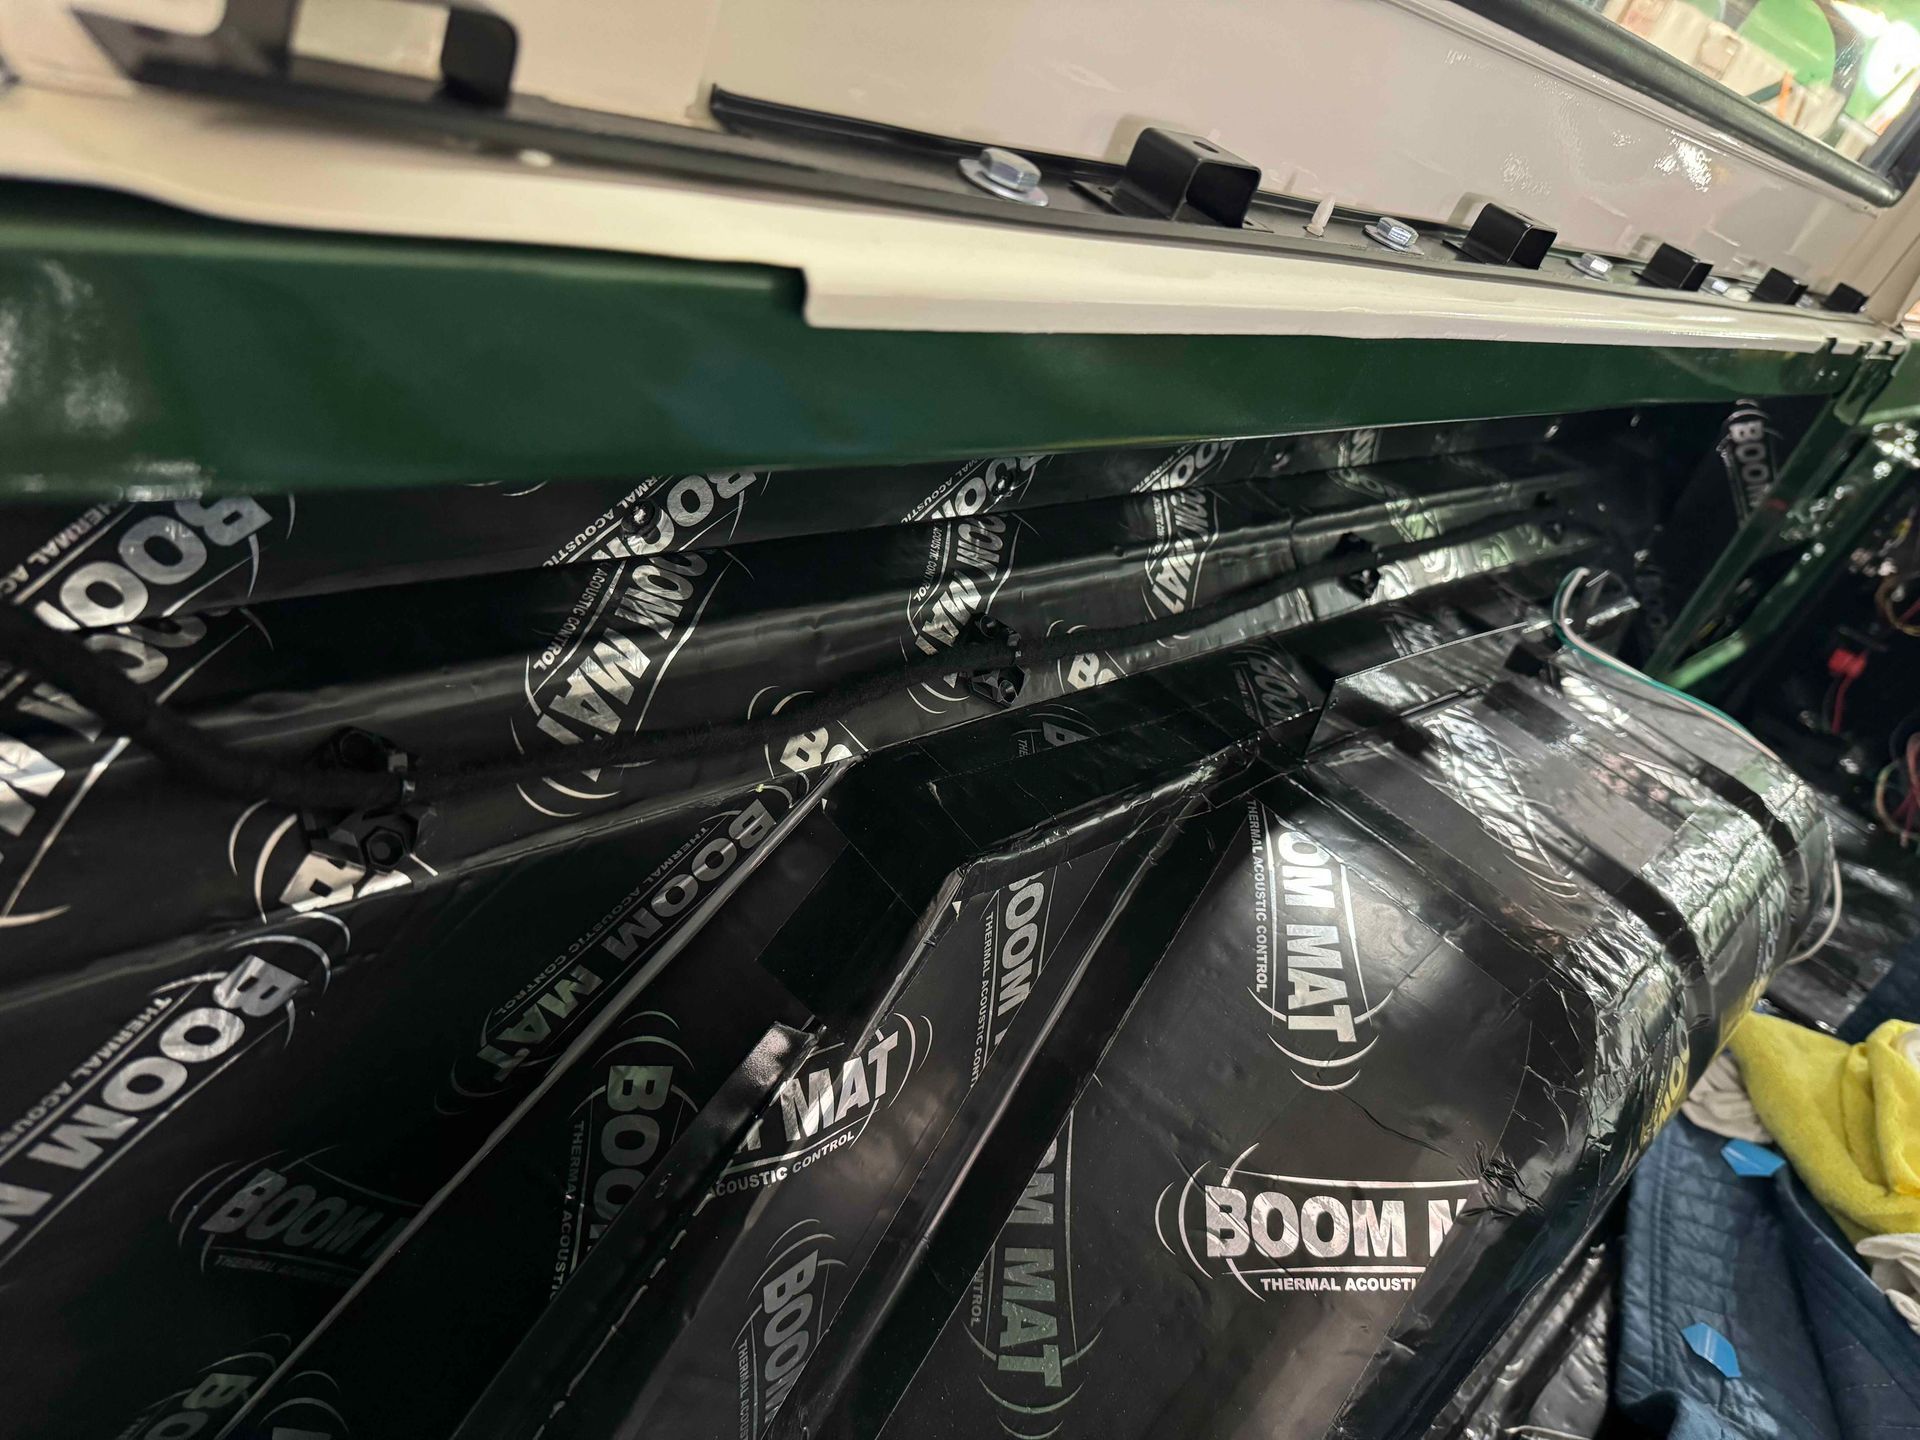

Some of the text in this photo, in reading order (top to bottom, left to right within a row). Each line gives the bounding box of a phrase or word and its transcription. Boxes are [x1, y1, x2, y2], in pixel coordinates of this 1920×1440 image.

[27, 501, 118, 565] HERMAL
[34, 497, 273, 632] BOO
[533, 567, 609, 671] ACOUSTIC CONTROL
[476, 798, 777, 1083] BOOM MAT
[495, 826, 710, 1016] THERMAL ACOUSTIC CONTROL
[982, 911, 994, 977] THERMAL
[998, 871, 1046, 1017] OOM
[1246, 800, 1270, 993] THERMAL ACOUSTIC CONTROL
[975, 980, 990, 1046] ACOUSTIC
[1286, 924, 1357, 1043] MAT
[26, 955, 309, 1171] BOOM
[70, 996, 173, 1080] THERMAL
[780, 1030, 899, 1142] MAT
[563, 1120, 585, 1206] THERMAL
[589, 1065, 675, 1240] BOO
[708, 1166, 788, 1199] ACOUSTIC
[792, 1130, 856, 1174] CONTROL
[199, 1168, 385, 1256] BOOM
[1205, 1184, 1407, 1259] BOOM
[998, 1247, 1063, 1388] MAT
[1260, 1277, 1341, 1292] THERMAL
[737, 1339, 751, 1399] THERMAL
